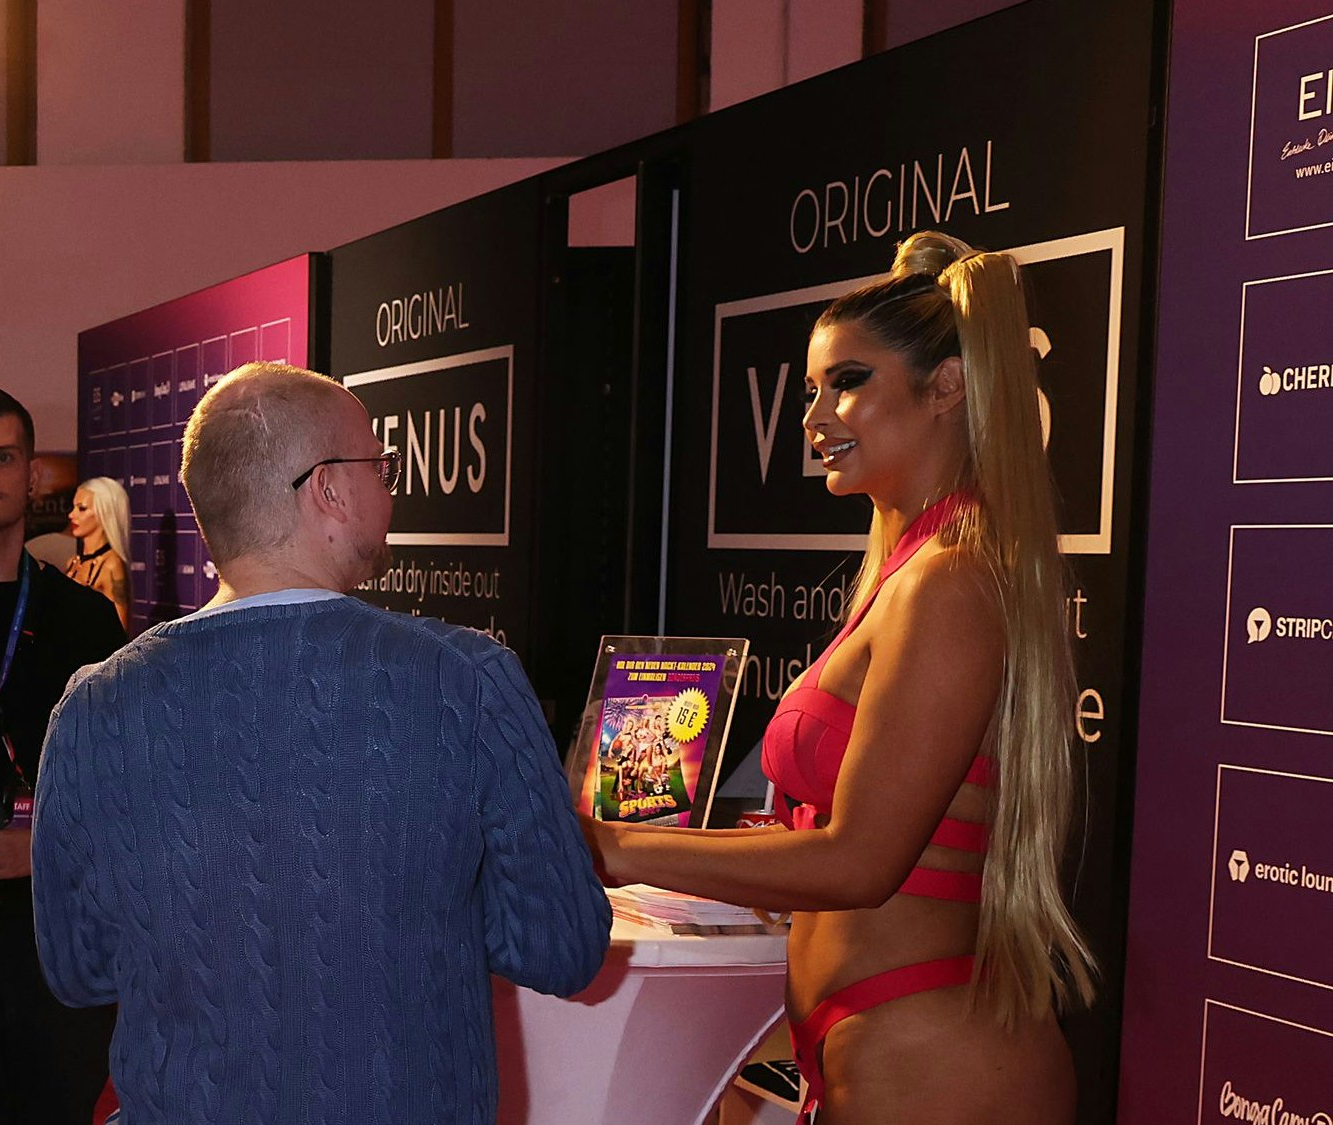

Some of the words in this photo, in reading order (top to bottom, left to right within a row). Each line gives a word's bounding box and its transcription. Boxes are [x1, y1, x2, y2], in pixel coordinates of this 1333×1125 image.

[1299, 69, 1333, 120] EI
[790, 140, 1010, 254] ORIGINAL
[376, 282, 470, 346] ORIGINAL
[372, 402, 486, 496] ENUS
[406, 560, 428, 602] dry
[430, 562, 471, 597] inside
[474, 567, 501, 599] out
[719, 571, 786, 618] Wash
[793, 573, 847, 623] and
[1276, 616, 1333, 640] STRIPC
[676, 707, 689, 725] 15
[13, 802, 31, 811] TAFF
[1255, 862, 1299, 886] erotic
[1301, 865, 1333, 893] loun
